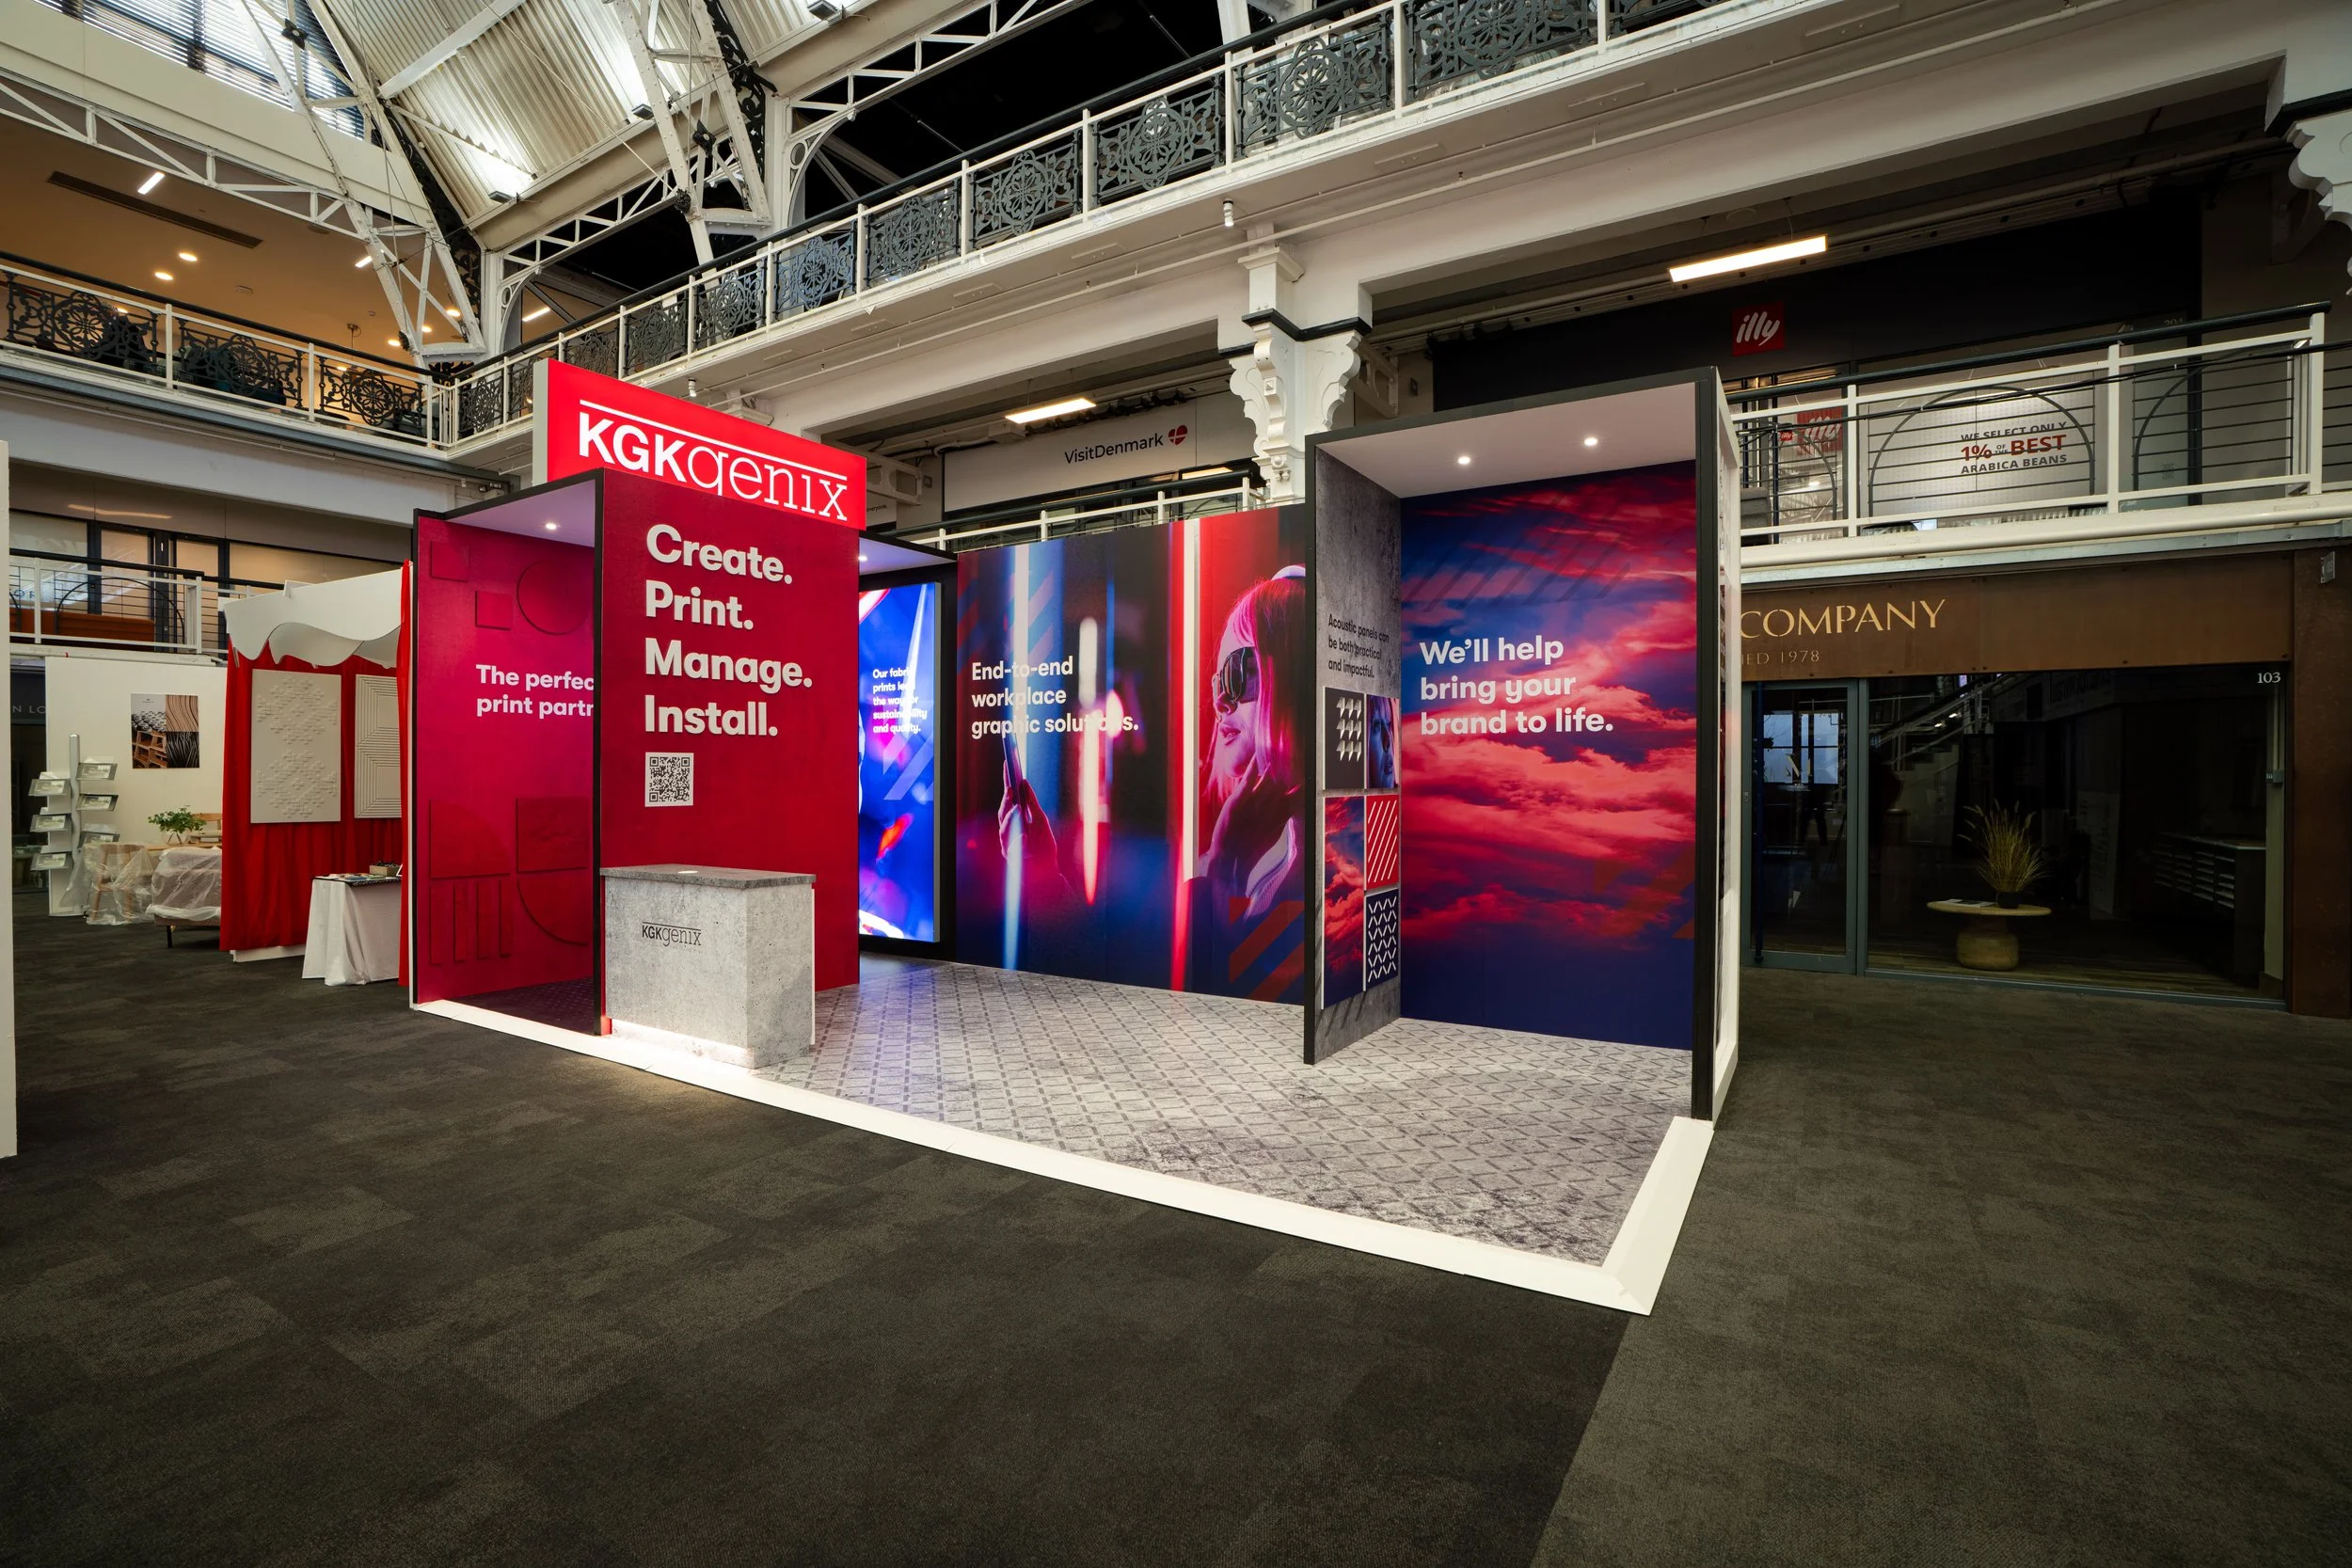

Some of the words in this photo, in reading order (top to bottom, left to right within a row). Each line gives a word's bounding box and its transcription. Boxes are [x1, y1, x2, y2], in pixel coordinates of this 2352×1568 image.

[1736, 311, 1781, 346] illy
[1983, 426, 2026, 438] SELECT
[1064, 433, 1164, 464] VisitDenmark
[1961, 444, 1993, 461] 1%
[2010, 434, 2067, 456] BEST
[1961, 460, 2019, 474] ARABICA
[2023, 454, 2067, 467] BEANS
[646, 523, 793, 585] Create.
[645, 579, 755, 630] Print.
[1328, 613, 1357, 634] Acoustic
[1358, 626, 1378, 640] panels
[1378, 632, 1390, 643] can
[1740, 598, 1946, 639] COMPANY
[1328, 634, 1338, 649] be
[1339, 637, 1354, 653] both
[1354, 642, 1382, 659] practical
[1498, 635, 1564, 665] help
[1781, 649, 1820, 663] 1978
[476, 664, 519, 686] The
[526, 671, 594, 691] perfec
[644, 637, 813, 694] Manage.
[872, 669, 888, 678] Our
[972, 656, 1073, 681] End-to-end
[1328, 658, 1342, 672] and
[1343, 659, 1375, 677] impactful.
[2257, 672, 2281, 684] 103
[872, 682, 896, 694] prints
[972, 687, 1067, 709] workplace
[1421, 675, 1496, 705] bring
[1505, 676, 1576, 704] your
[477, 694, 532, 717] print
[872, 697, 886, 705] the
[644, 694, 779, 736] Install.
[1421, 709, 1506, 736] brand
[1515, 711, 1547, 734] to
[1555, 707, 1613, 733] life.
[872, 723, 889, 734] and
[642, 925, 702, 946] KGKgenix
